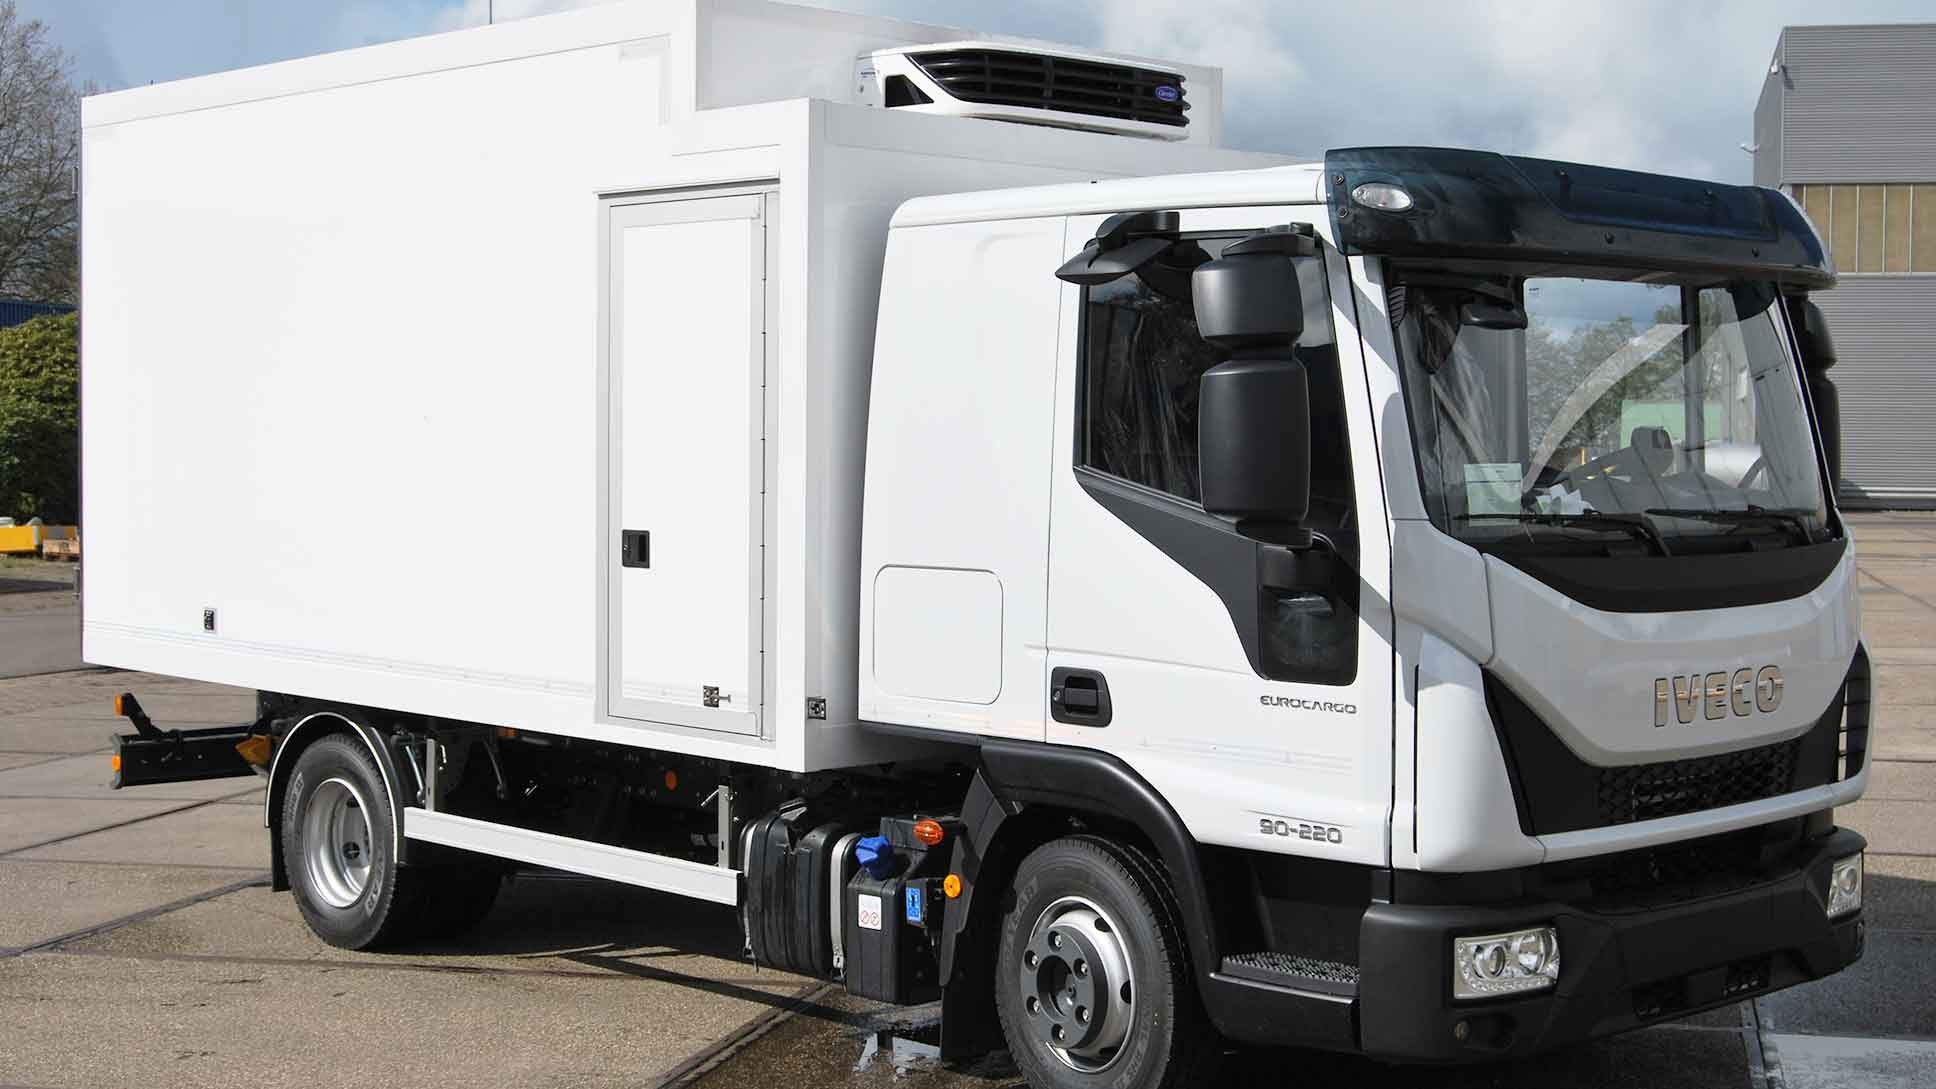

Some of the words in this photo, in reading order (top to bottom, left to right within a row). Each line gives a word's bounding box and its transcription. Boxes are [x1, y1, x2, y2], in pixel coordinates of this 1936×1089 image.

[1260, 695, 1357, 714] EUROCARGO
[1654, 665, 1784, 727] IVECO
[1260, 818, 1342, 844] 90-220
